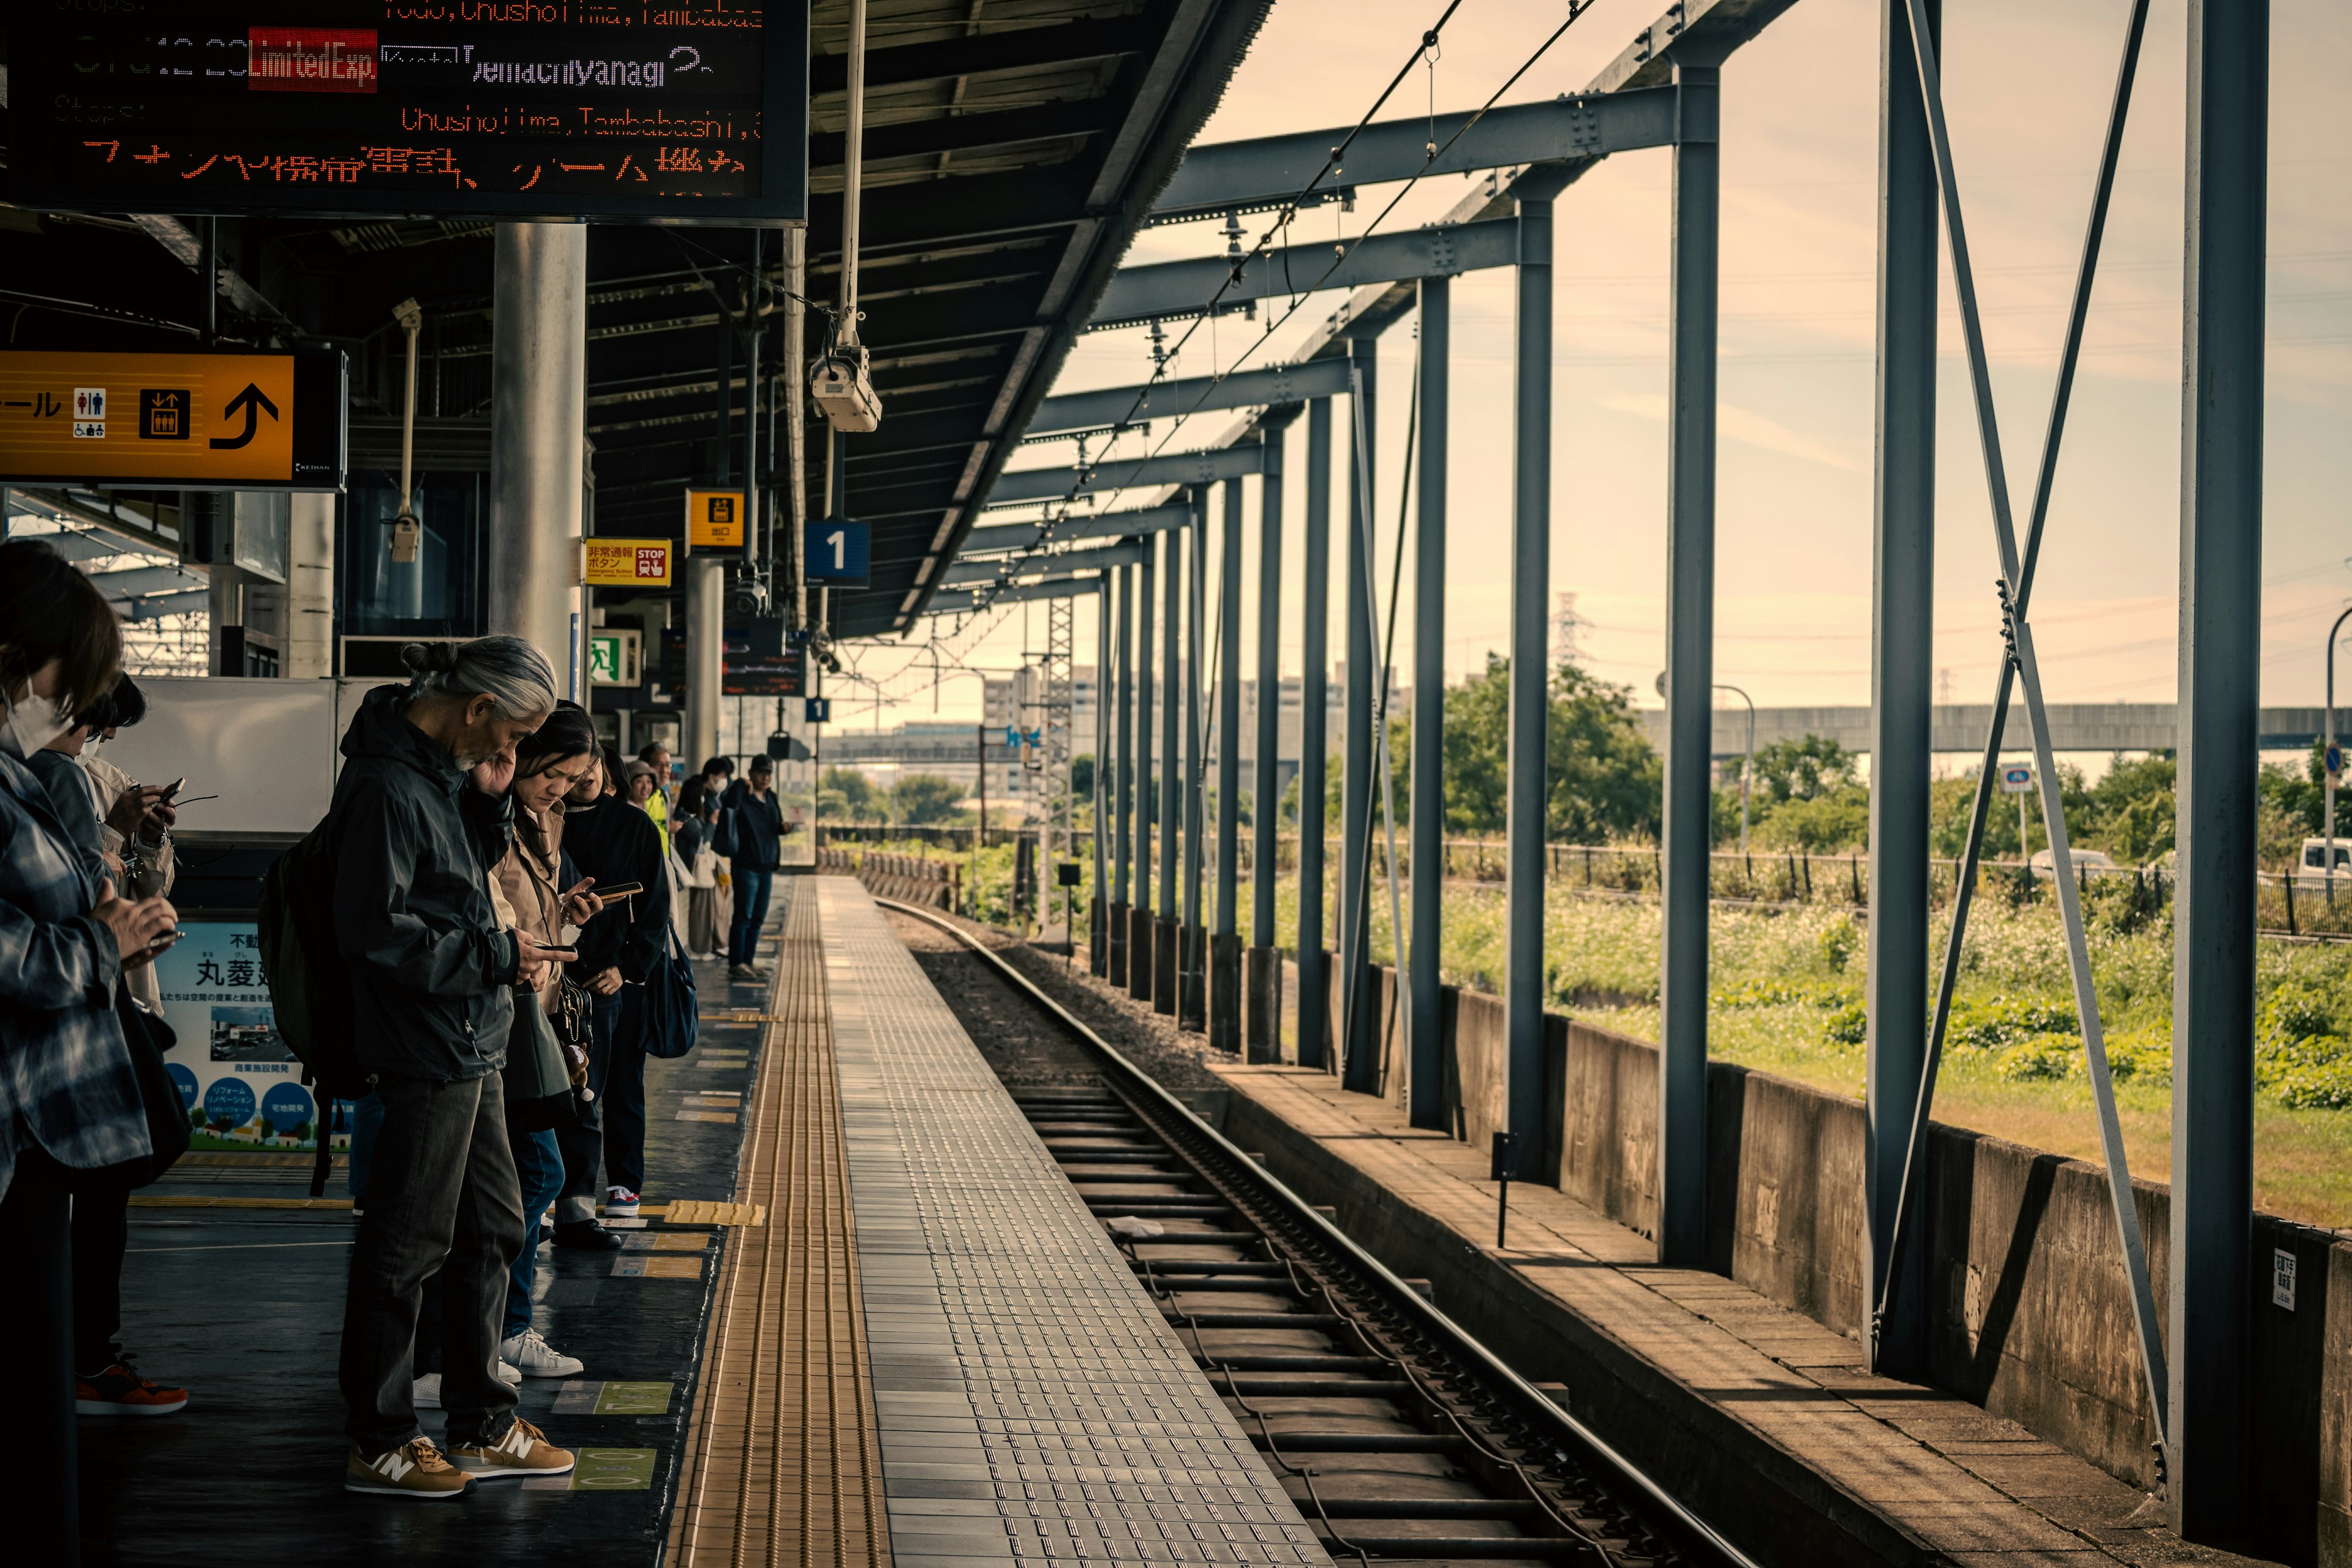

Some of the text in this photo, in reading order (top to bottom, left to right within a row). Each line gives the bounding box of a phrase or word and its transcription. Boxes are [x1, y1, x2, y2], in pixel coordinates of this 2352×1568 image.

[248, 39, 376, 87] LimitedExp.
[0, 392, 61, 418] ール
[589, 546, 633, 558] 非常通報
[638, 549, 665, 559] STOP
[827, 530, 844, 569] 1
[589, 558, 620, 568] ボタン
[815, 701, 823, 717] 1
[235, 1064, 289, 1073] 商業施設開発
[272, 1104, 304, 1112] 宅地開発
[507, 1431, 535, 1459] N
[379, 1453, 415, 1482] N
